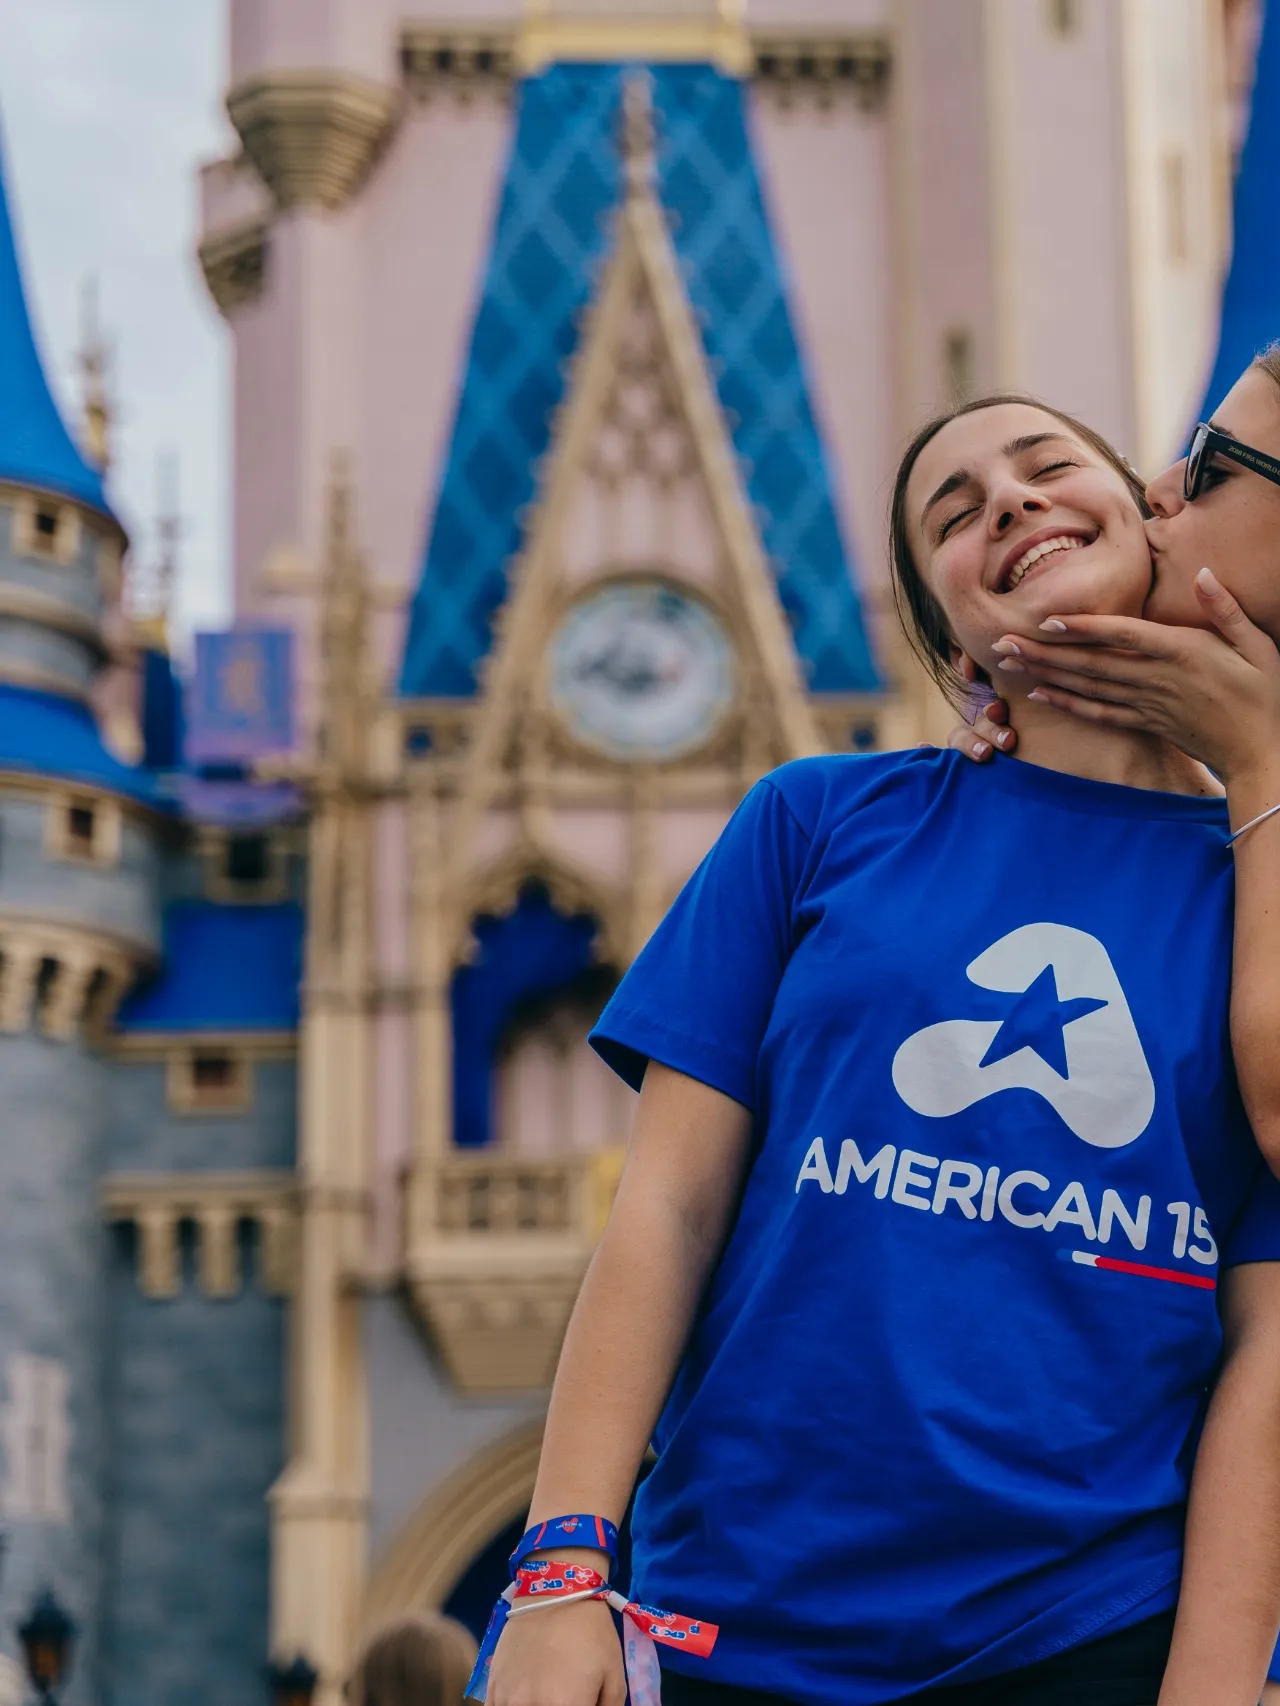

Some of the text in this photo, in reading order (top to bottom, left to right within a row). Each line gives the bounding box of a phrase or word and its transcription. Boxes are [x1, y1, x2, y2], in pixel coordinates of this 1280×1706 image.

[1242, 452, 1255, 462] FIFA
[1255, 459, 1277, 473] WORLD
[796, 1137, 1219, 1265] AMERICAN 15
